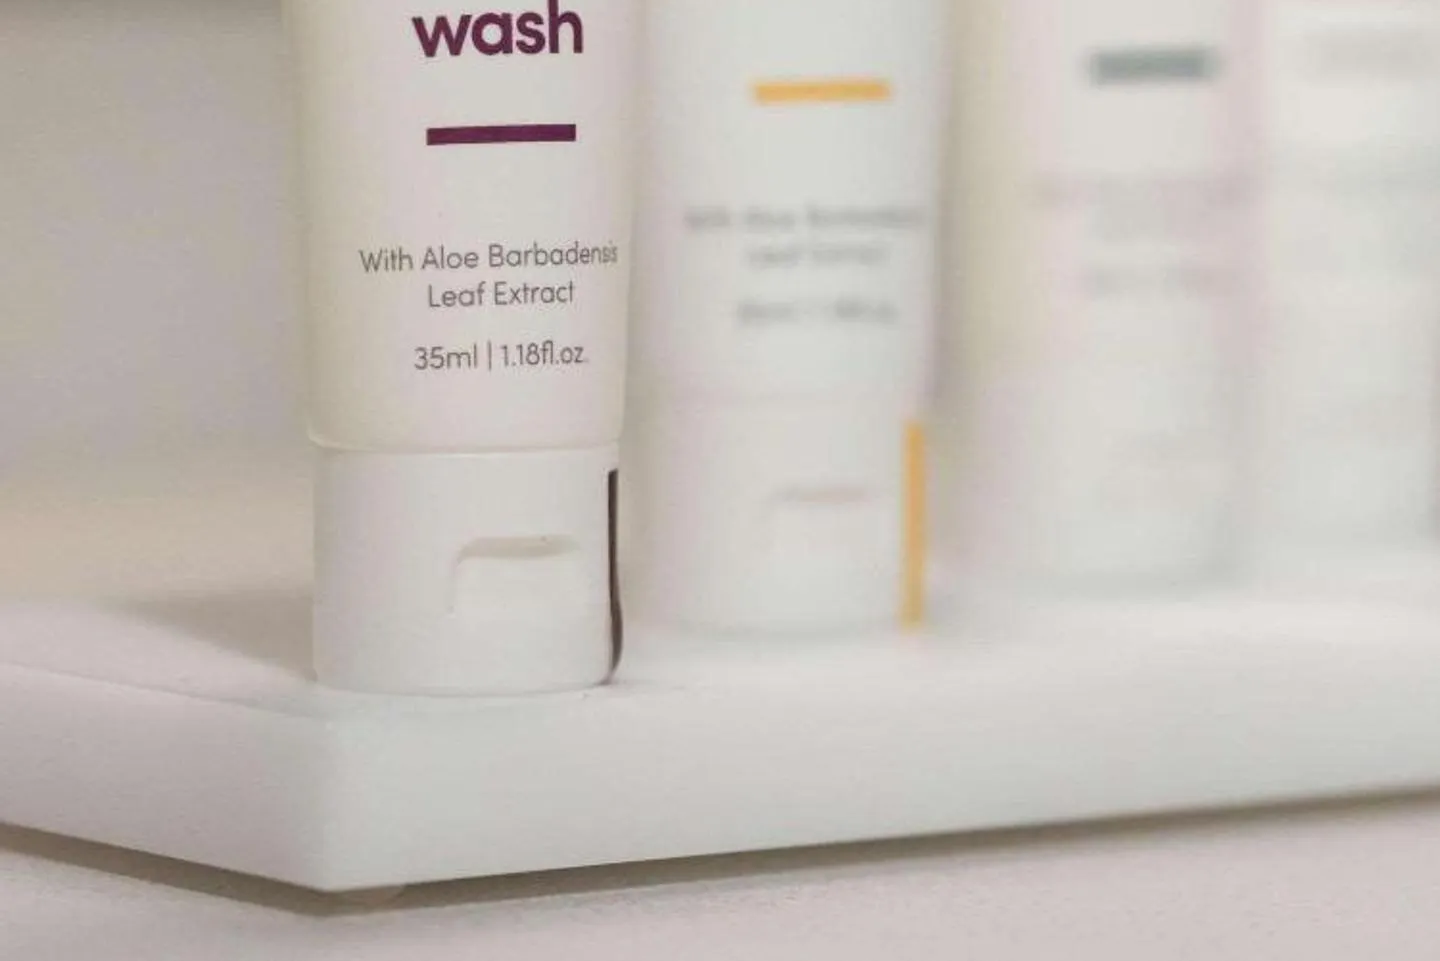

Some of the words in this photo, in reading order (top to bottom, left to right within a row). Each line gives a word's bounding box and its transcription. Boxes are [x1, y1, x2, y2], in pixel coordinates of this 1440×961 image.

[359, 247, 413, 273] With
[421, 244, 480, 270] Aloe
[428, 281, 486, 308] Leaf
[494, 280, 576, 305] Extract
[414, 344, 477, 370] 35ml
